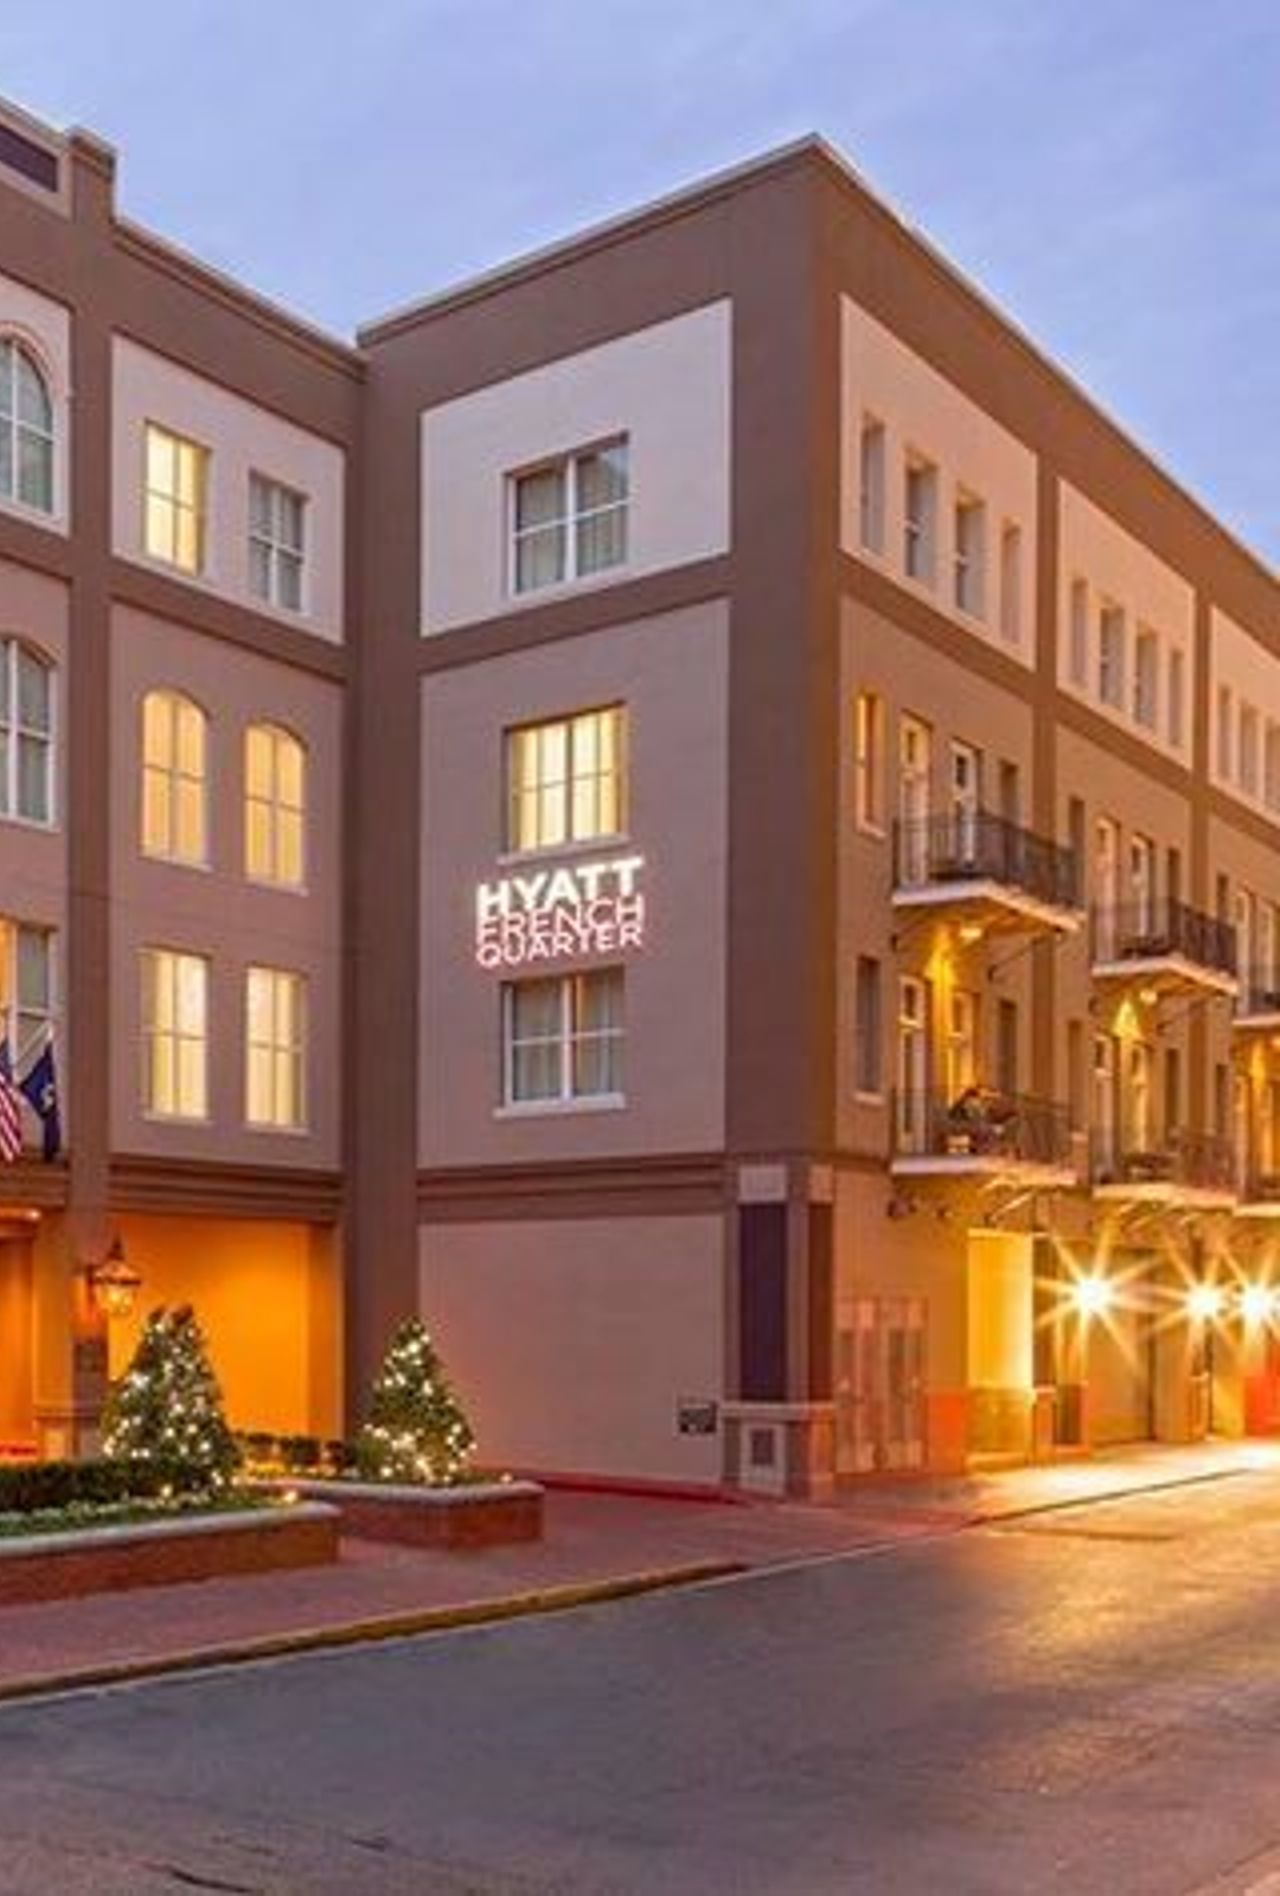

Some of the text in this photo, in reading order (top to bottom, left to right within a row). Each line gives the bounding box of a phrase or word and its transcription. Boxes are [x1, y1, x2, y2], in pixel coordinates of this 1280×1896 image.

[476, 855, 644, 919] HYATT
[476, 893, 645, 946] FRENCH
[476, 921, 643, 969] QUARTER
